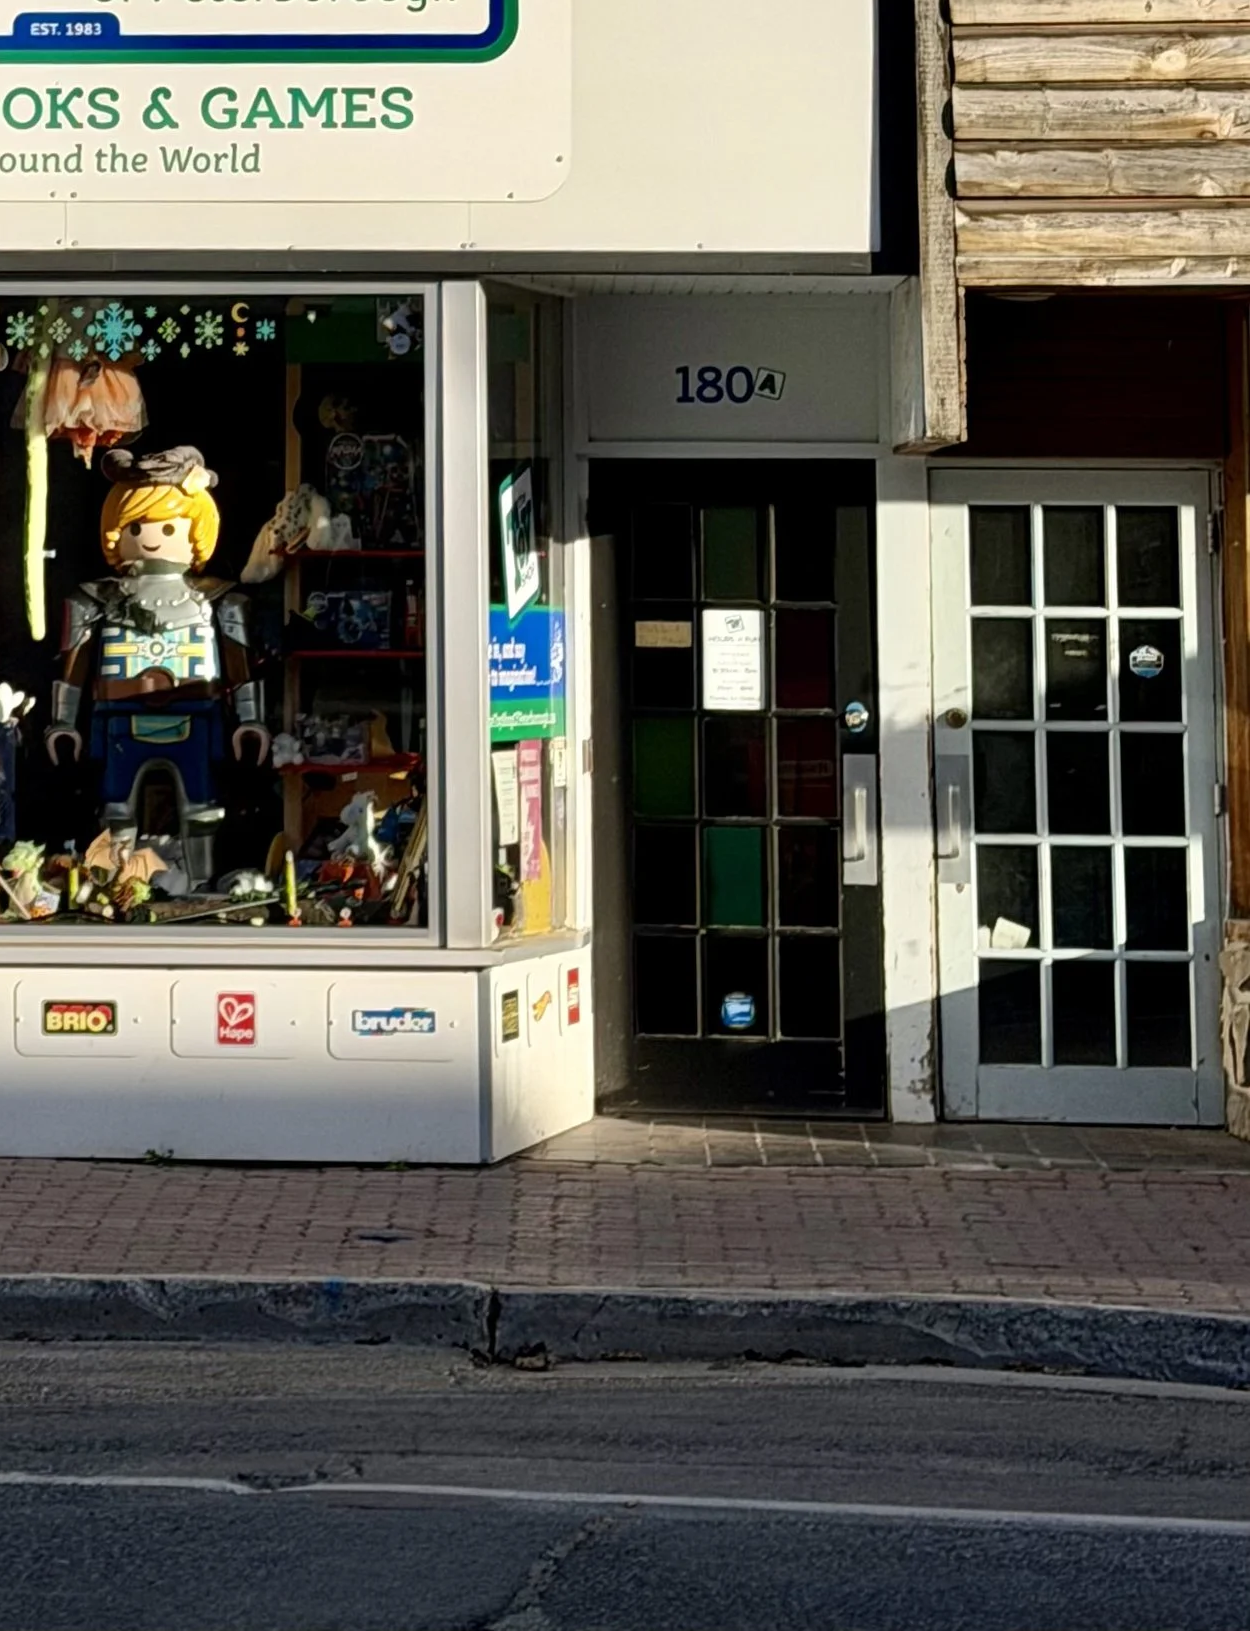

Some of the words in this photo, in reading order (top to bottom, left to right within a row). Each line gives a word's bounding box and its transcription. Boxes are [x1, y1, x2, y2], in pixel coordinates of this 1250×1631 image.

[30, 22, 62, 36] EST.
[65, 22, 102, 36] 1983
[143, 87, 180, 130] &
[200, 87, 414, 130] GAMES
[94, 143, 148, 174] the
[159, 143, 261, 174] World
[46, 1010, 108, 1032] BRIO
[354, 1011, 432, 1031] bruder
[220, 1026, 254, 1042] Hape
